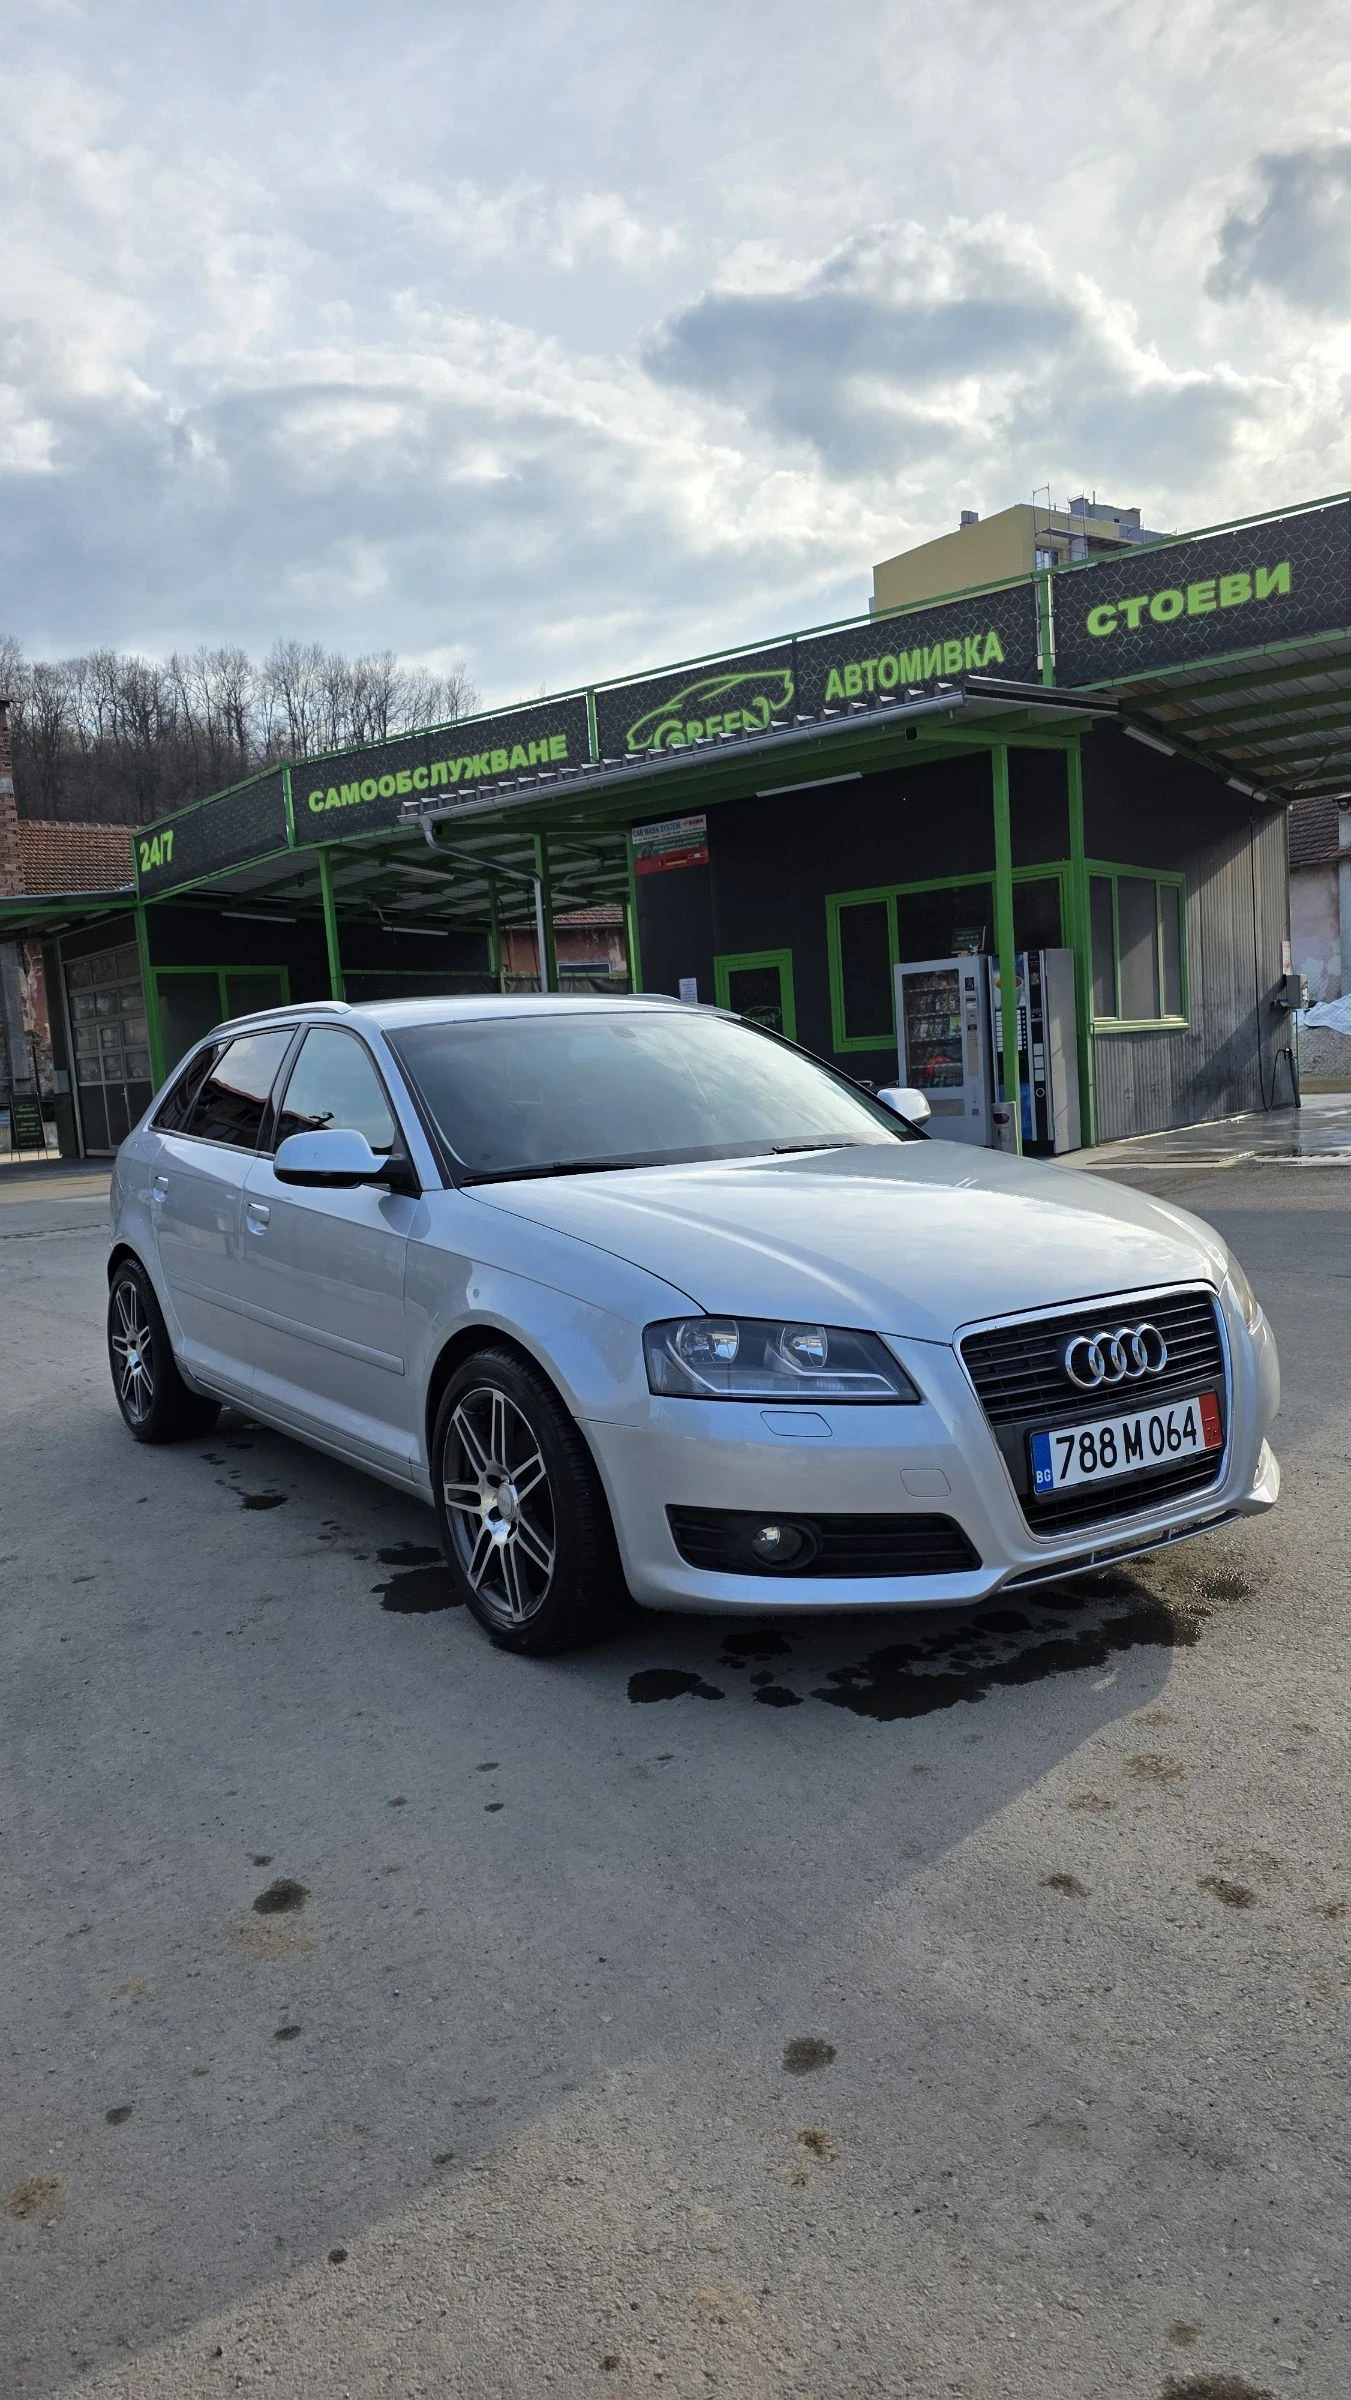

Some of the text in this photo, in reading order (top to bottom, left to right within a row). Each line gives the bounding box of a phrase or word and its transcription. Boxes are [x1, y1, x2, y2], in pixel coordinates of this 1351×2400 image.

[1086, 562, 1291, 636] СТОЕВИ
[825, 631, 1005, 701] АВТОМИВКА
[308, 734, 569, 813] САМООБСЛУЖВАНЕ
[139, 830, 174, 872] 24/7
[659, 821, 681, 834] SYSTEM
[1036, 1469, 1051, 1484] BG
